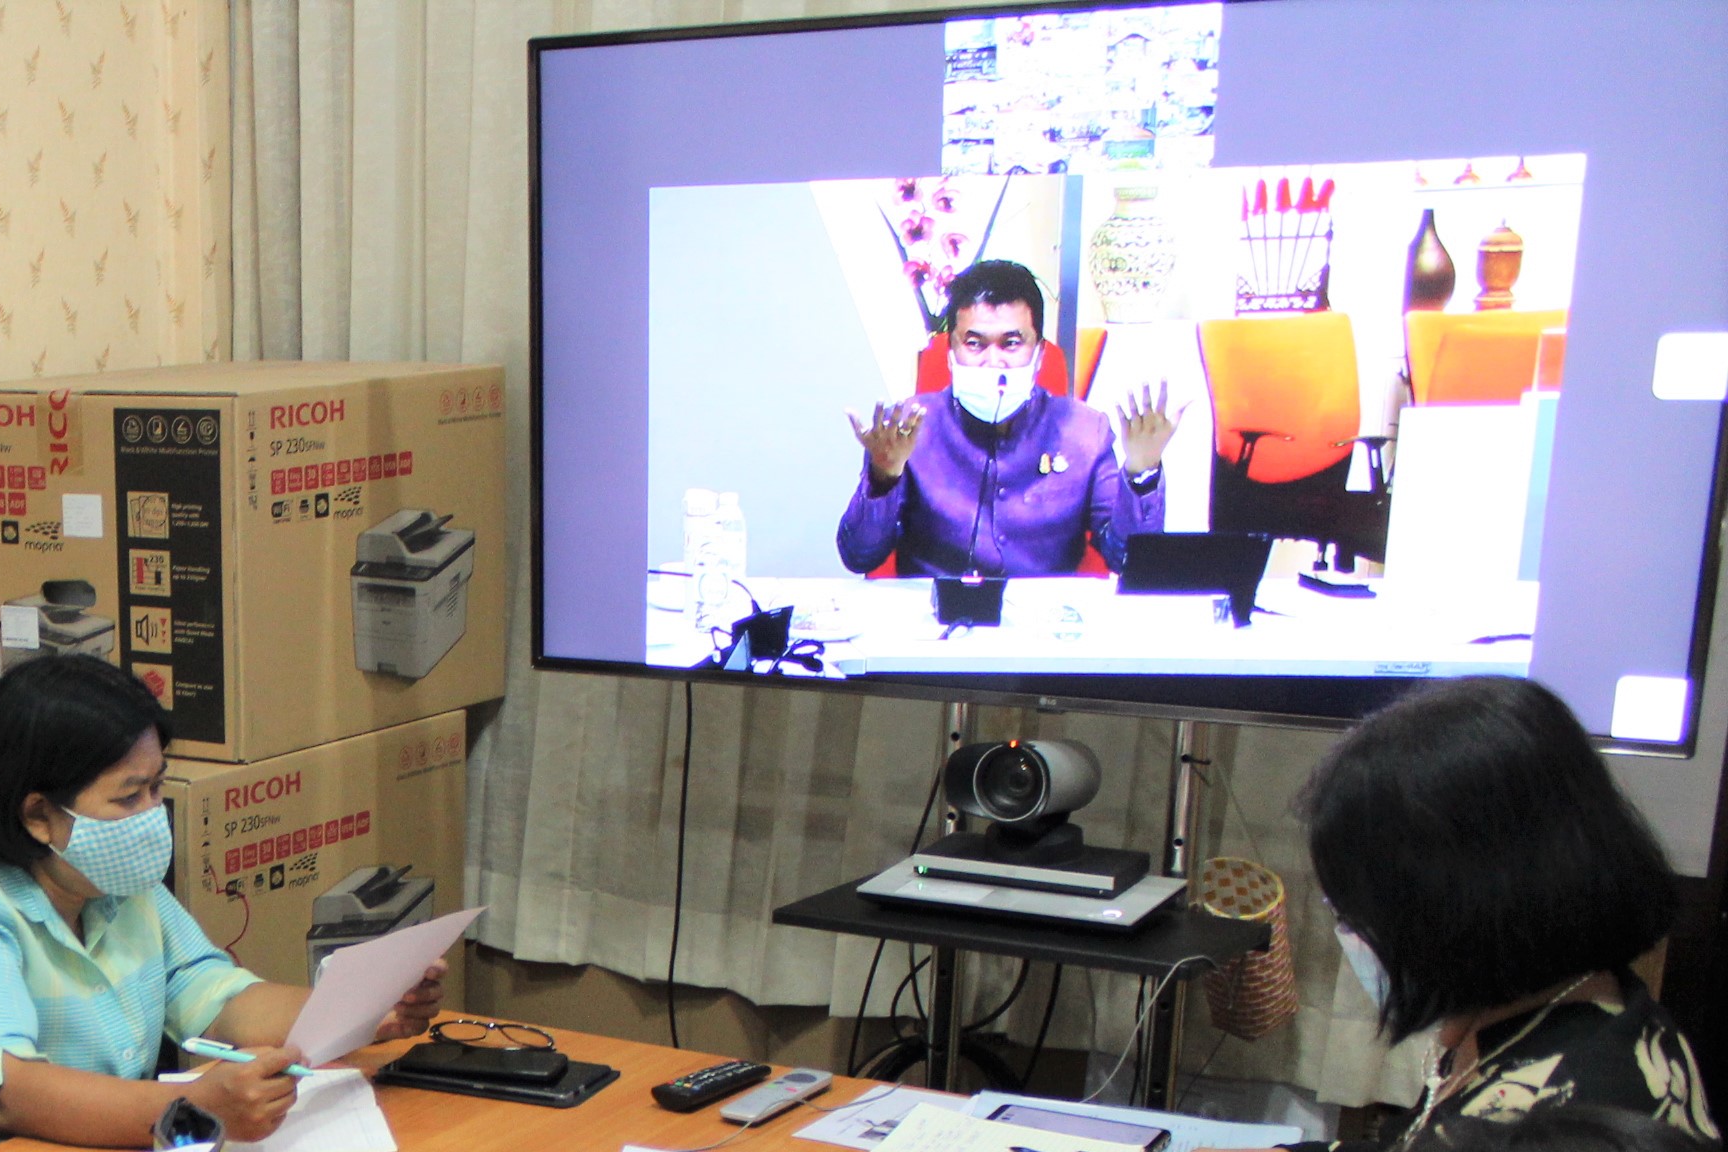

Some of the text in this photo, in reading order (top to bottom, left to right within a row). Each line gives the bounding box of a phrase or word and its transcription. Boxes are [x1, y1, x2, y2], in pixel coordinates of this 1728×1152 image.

[270, 400, 345, 429] RICOH
[270, 440, 282, 457] SP
[225, 771, 301, 812] RICOH
[225, 822, 237, 839] SP
